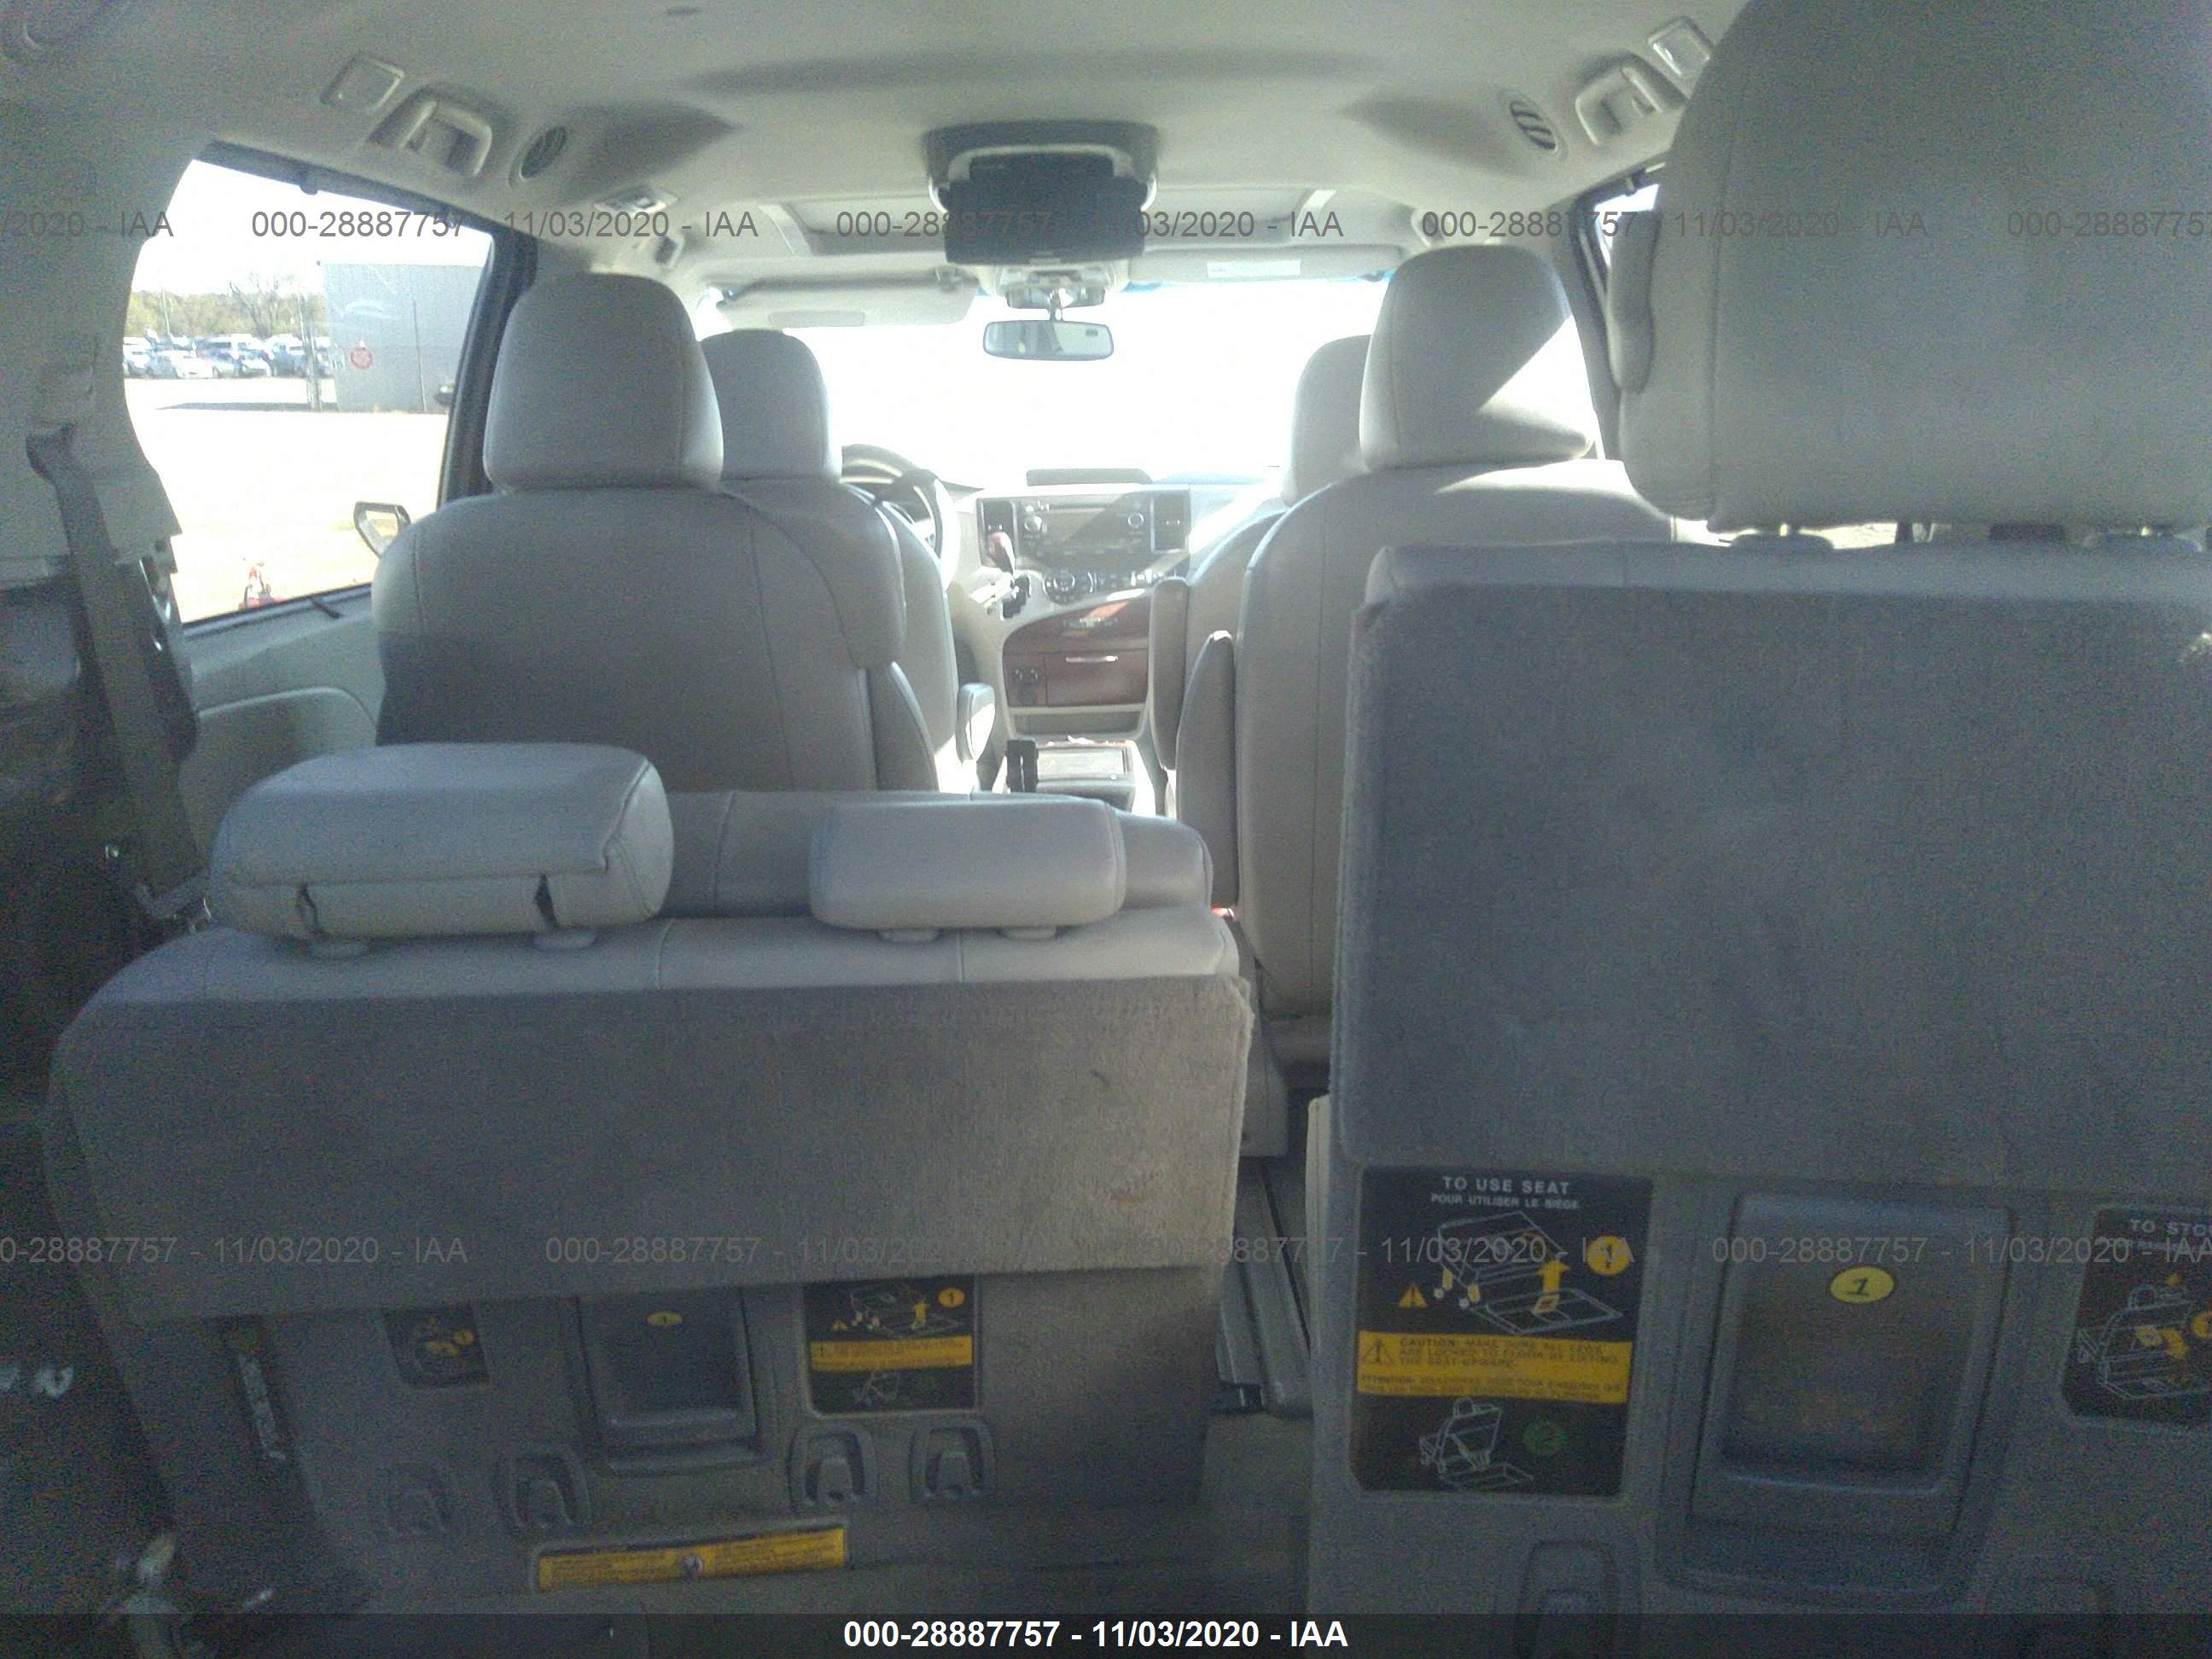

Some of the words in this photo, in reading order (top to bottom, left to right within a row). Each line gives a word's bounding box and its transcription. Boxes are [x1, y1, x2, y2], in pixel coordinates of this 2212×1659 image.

[1442, 1176, 1468, 1190] TO
[1476, 1178, 1513, 1193] USE
[1522, 1180, 1571, 1195] SEAT
[1430, 1192, 1464, 1204] POUR
[2129, 1218, 2157, 1234] TO
[2166, 1222, 2212, 1237] STO
